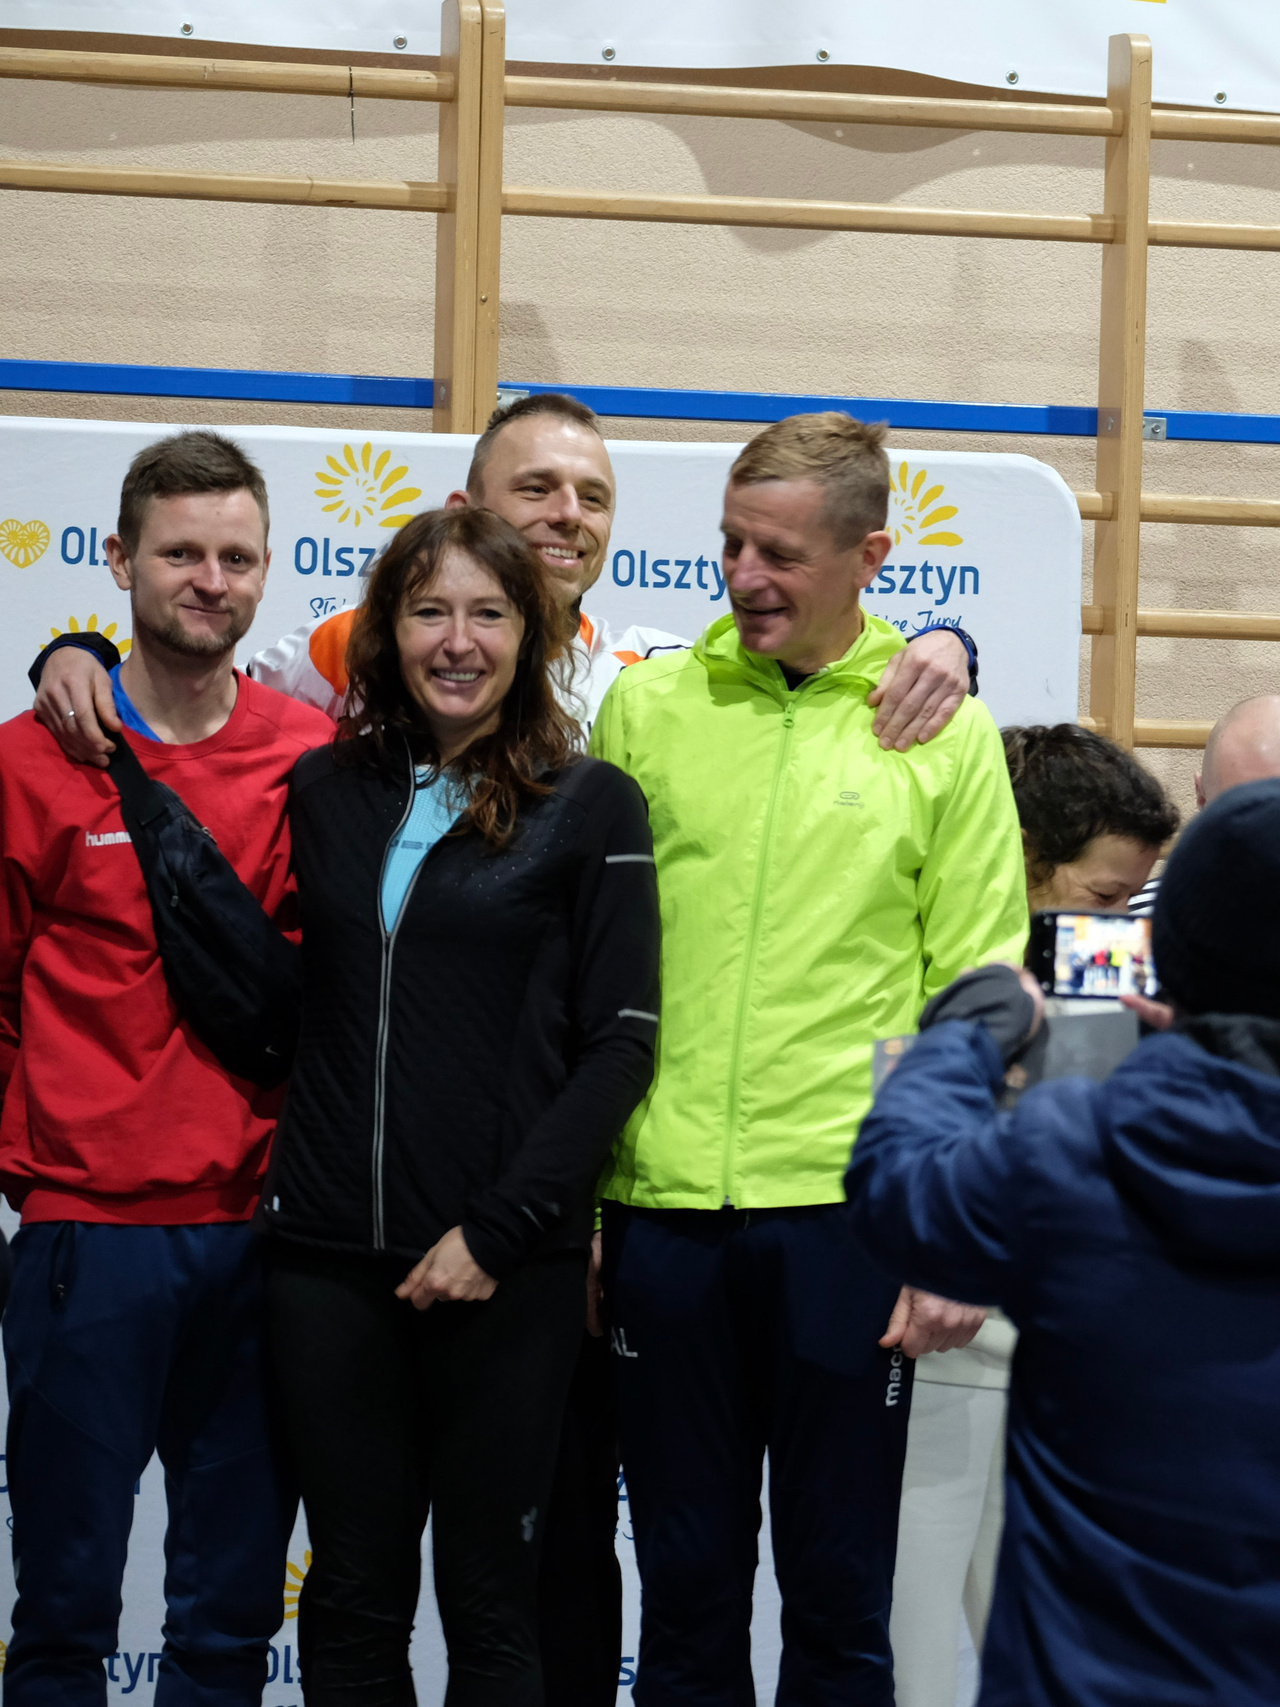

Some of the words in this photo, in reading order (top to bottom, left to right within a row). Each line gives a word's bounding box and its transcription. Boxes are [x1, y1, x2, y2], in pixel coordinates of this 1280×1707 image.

[294, 536, 384, 577] Olsz
[612, 549, 727, 601] Olszty
[865, 560, 979, 606] sztyn
